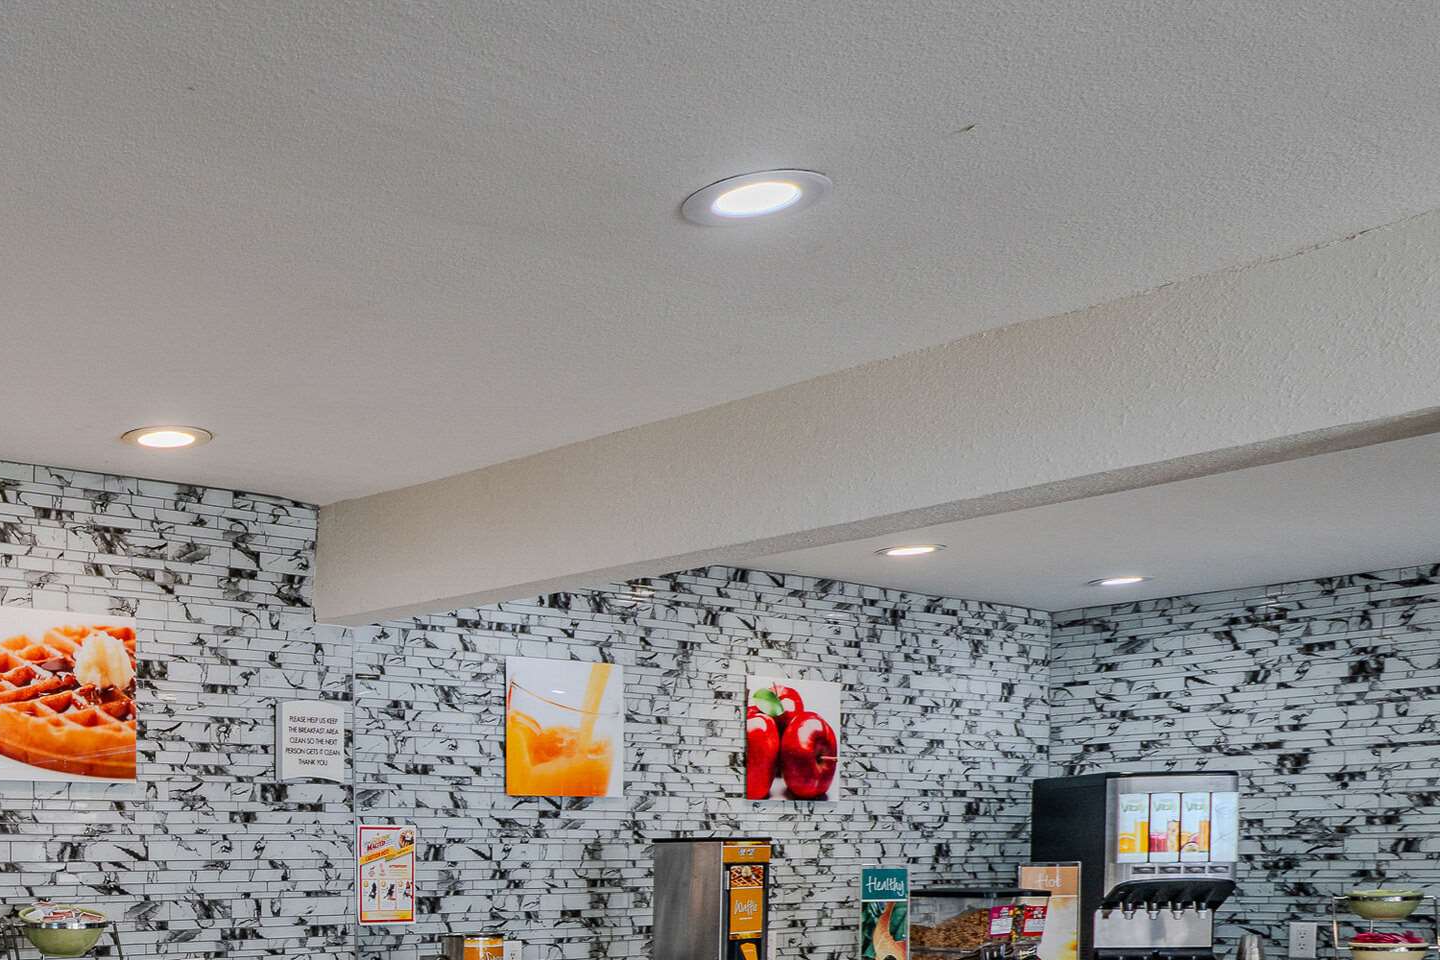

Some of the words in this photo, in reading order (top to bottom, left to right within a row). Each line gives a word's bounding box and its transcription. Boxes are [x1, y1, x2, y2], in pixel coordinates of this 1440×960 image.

[289, 715, 306, 723] PLEASE
[326, 717, 338, 725] KEEP
[298, 726, 325, 734] BREAKFAST
[286, 747, 305, 755] PERSON
[865, 876, 904, 897] Healthy
